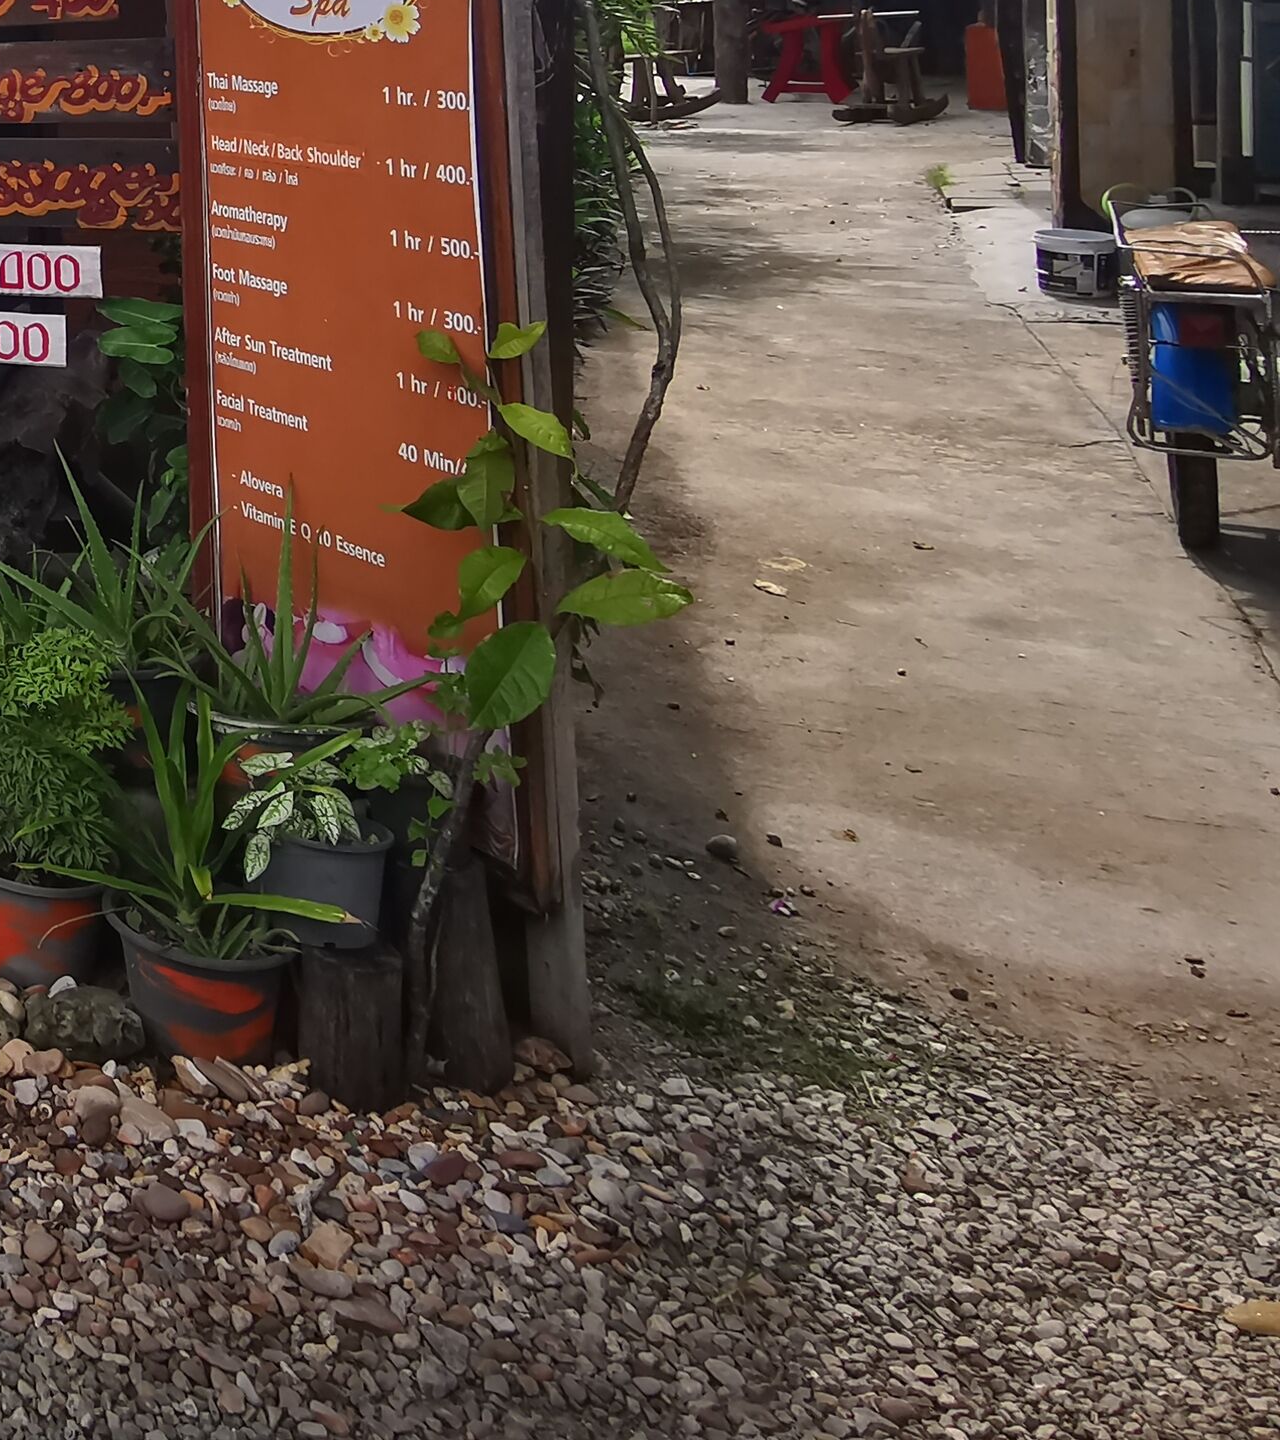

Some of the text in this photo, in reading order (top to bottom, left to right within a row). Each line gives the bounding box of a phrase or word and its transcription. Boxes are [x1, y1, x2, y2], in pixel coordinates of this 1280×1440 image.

[207, 73, 278, 98] Thai Massage
[382, 86, 391, 105] 1
[397, 86, 417, 107] hr.
[306, 146, 362, 170] Shoulder
[385, 158, 394, 176] 1
[400, 158, 417, 179] hr
[211, 199, 289, 233] Aromatherapy
[389, 229, 398, 248] 1
[404, 230, 422, 251] hr
[212, 263, 289, 298] Foot Massage
[392, 300, 401, 318] 1
[408, 302, 425, 324] hr
[214, 326, 242, 348] After
[244, 335, 267, 355] Sun
[268, 340, 333, 372] Treatment
[395, 371, 404, 390] 1
[411, 373, 428, 395] hr
[216, 389, 309, 432] Facial Treatment
[397, 442, 418, 463] 40
[239, 470, 284, 498] Alovera
[240, 500, 286, 533] Vitamin
[289, 518, 297, 536] E
[300, 522, 312, 544] Q
[335, 534, 386, 568] Essence
